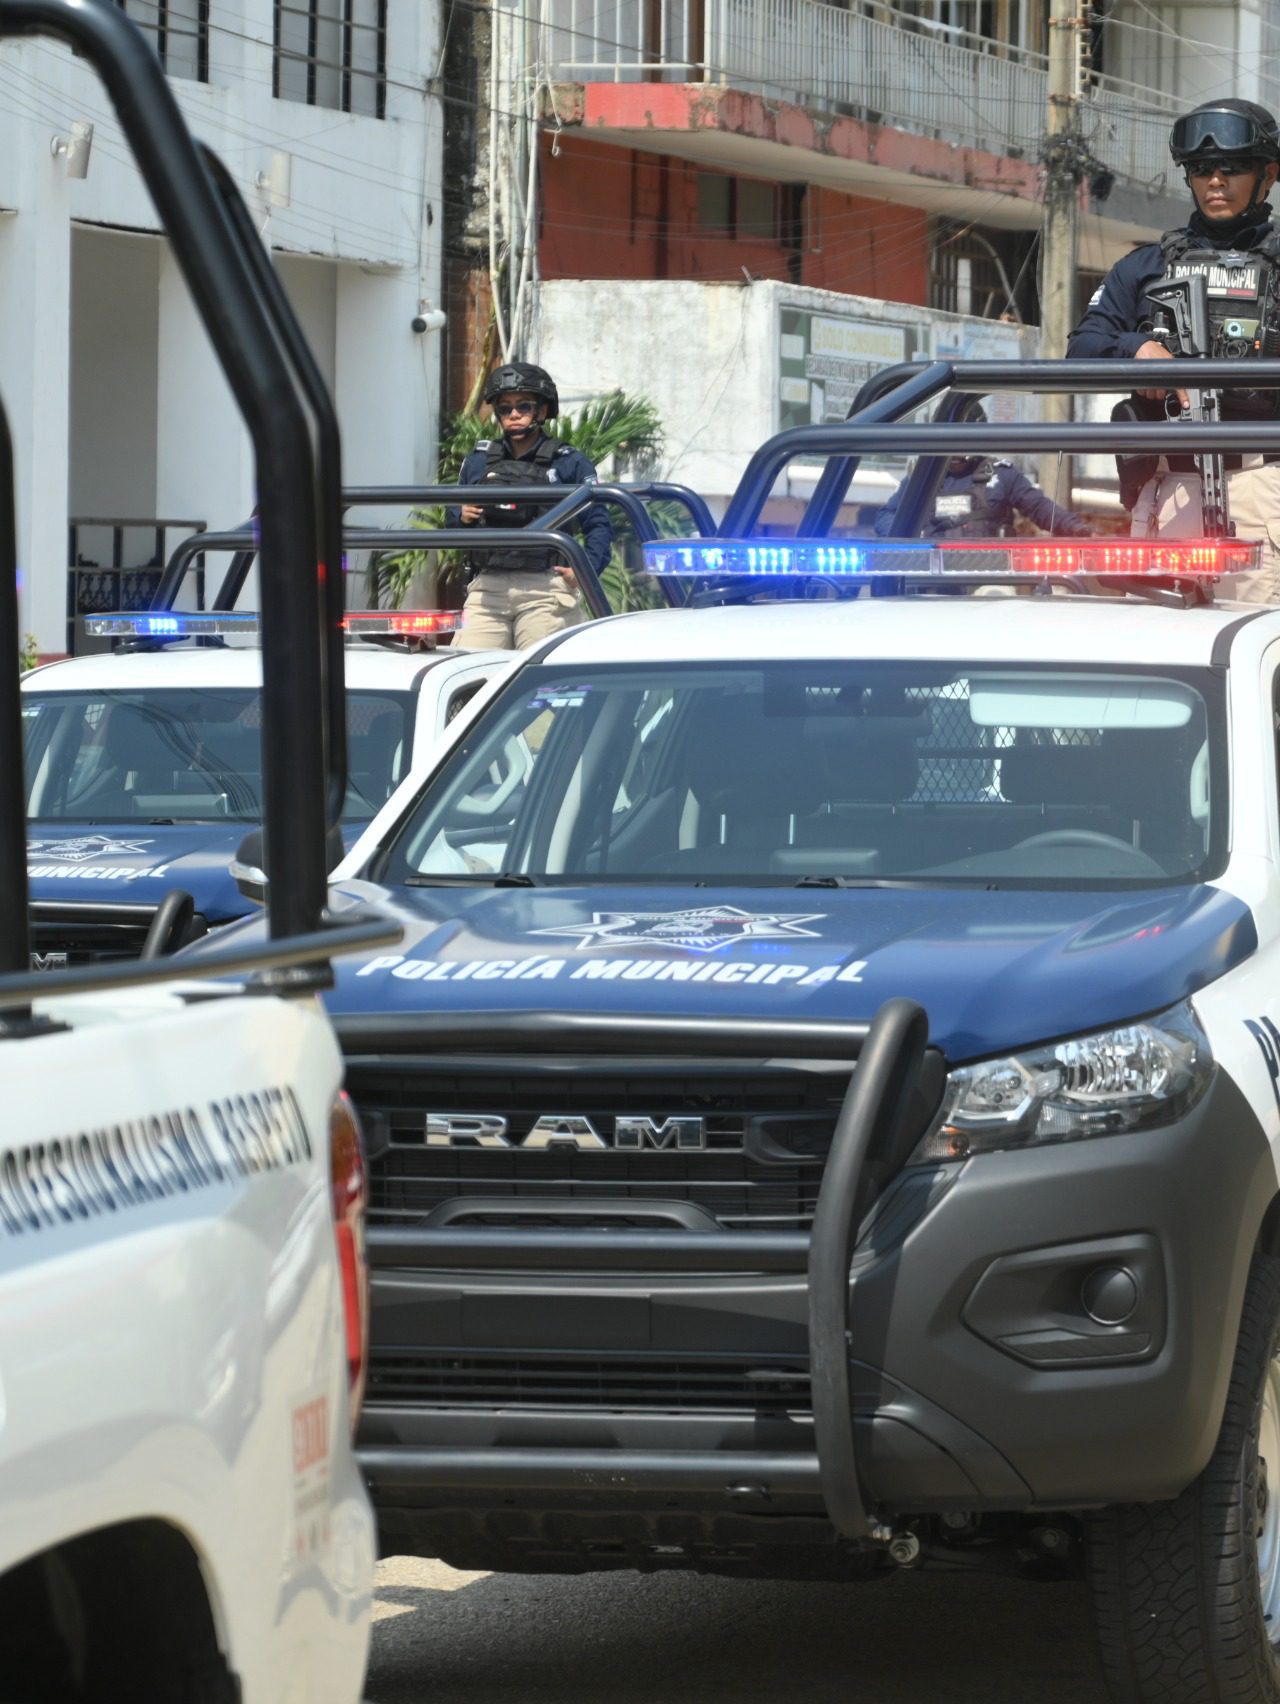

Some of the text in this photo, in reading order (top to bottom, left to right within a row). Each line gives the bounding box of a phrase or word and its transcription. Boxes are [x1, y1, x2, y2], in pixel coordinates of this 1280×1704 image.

[1208, 266, 1256, 289] MUNICIPAL
[356, 955, 868, 985] POLICÍA MUNICIPAL
[426, 1113, 706, 1149] RAM
